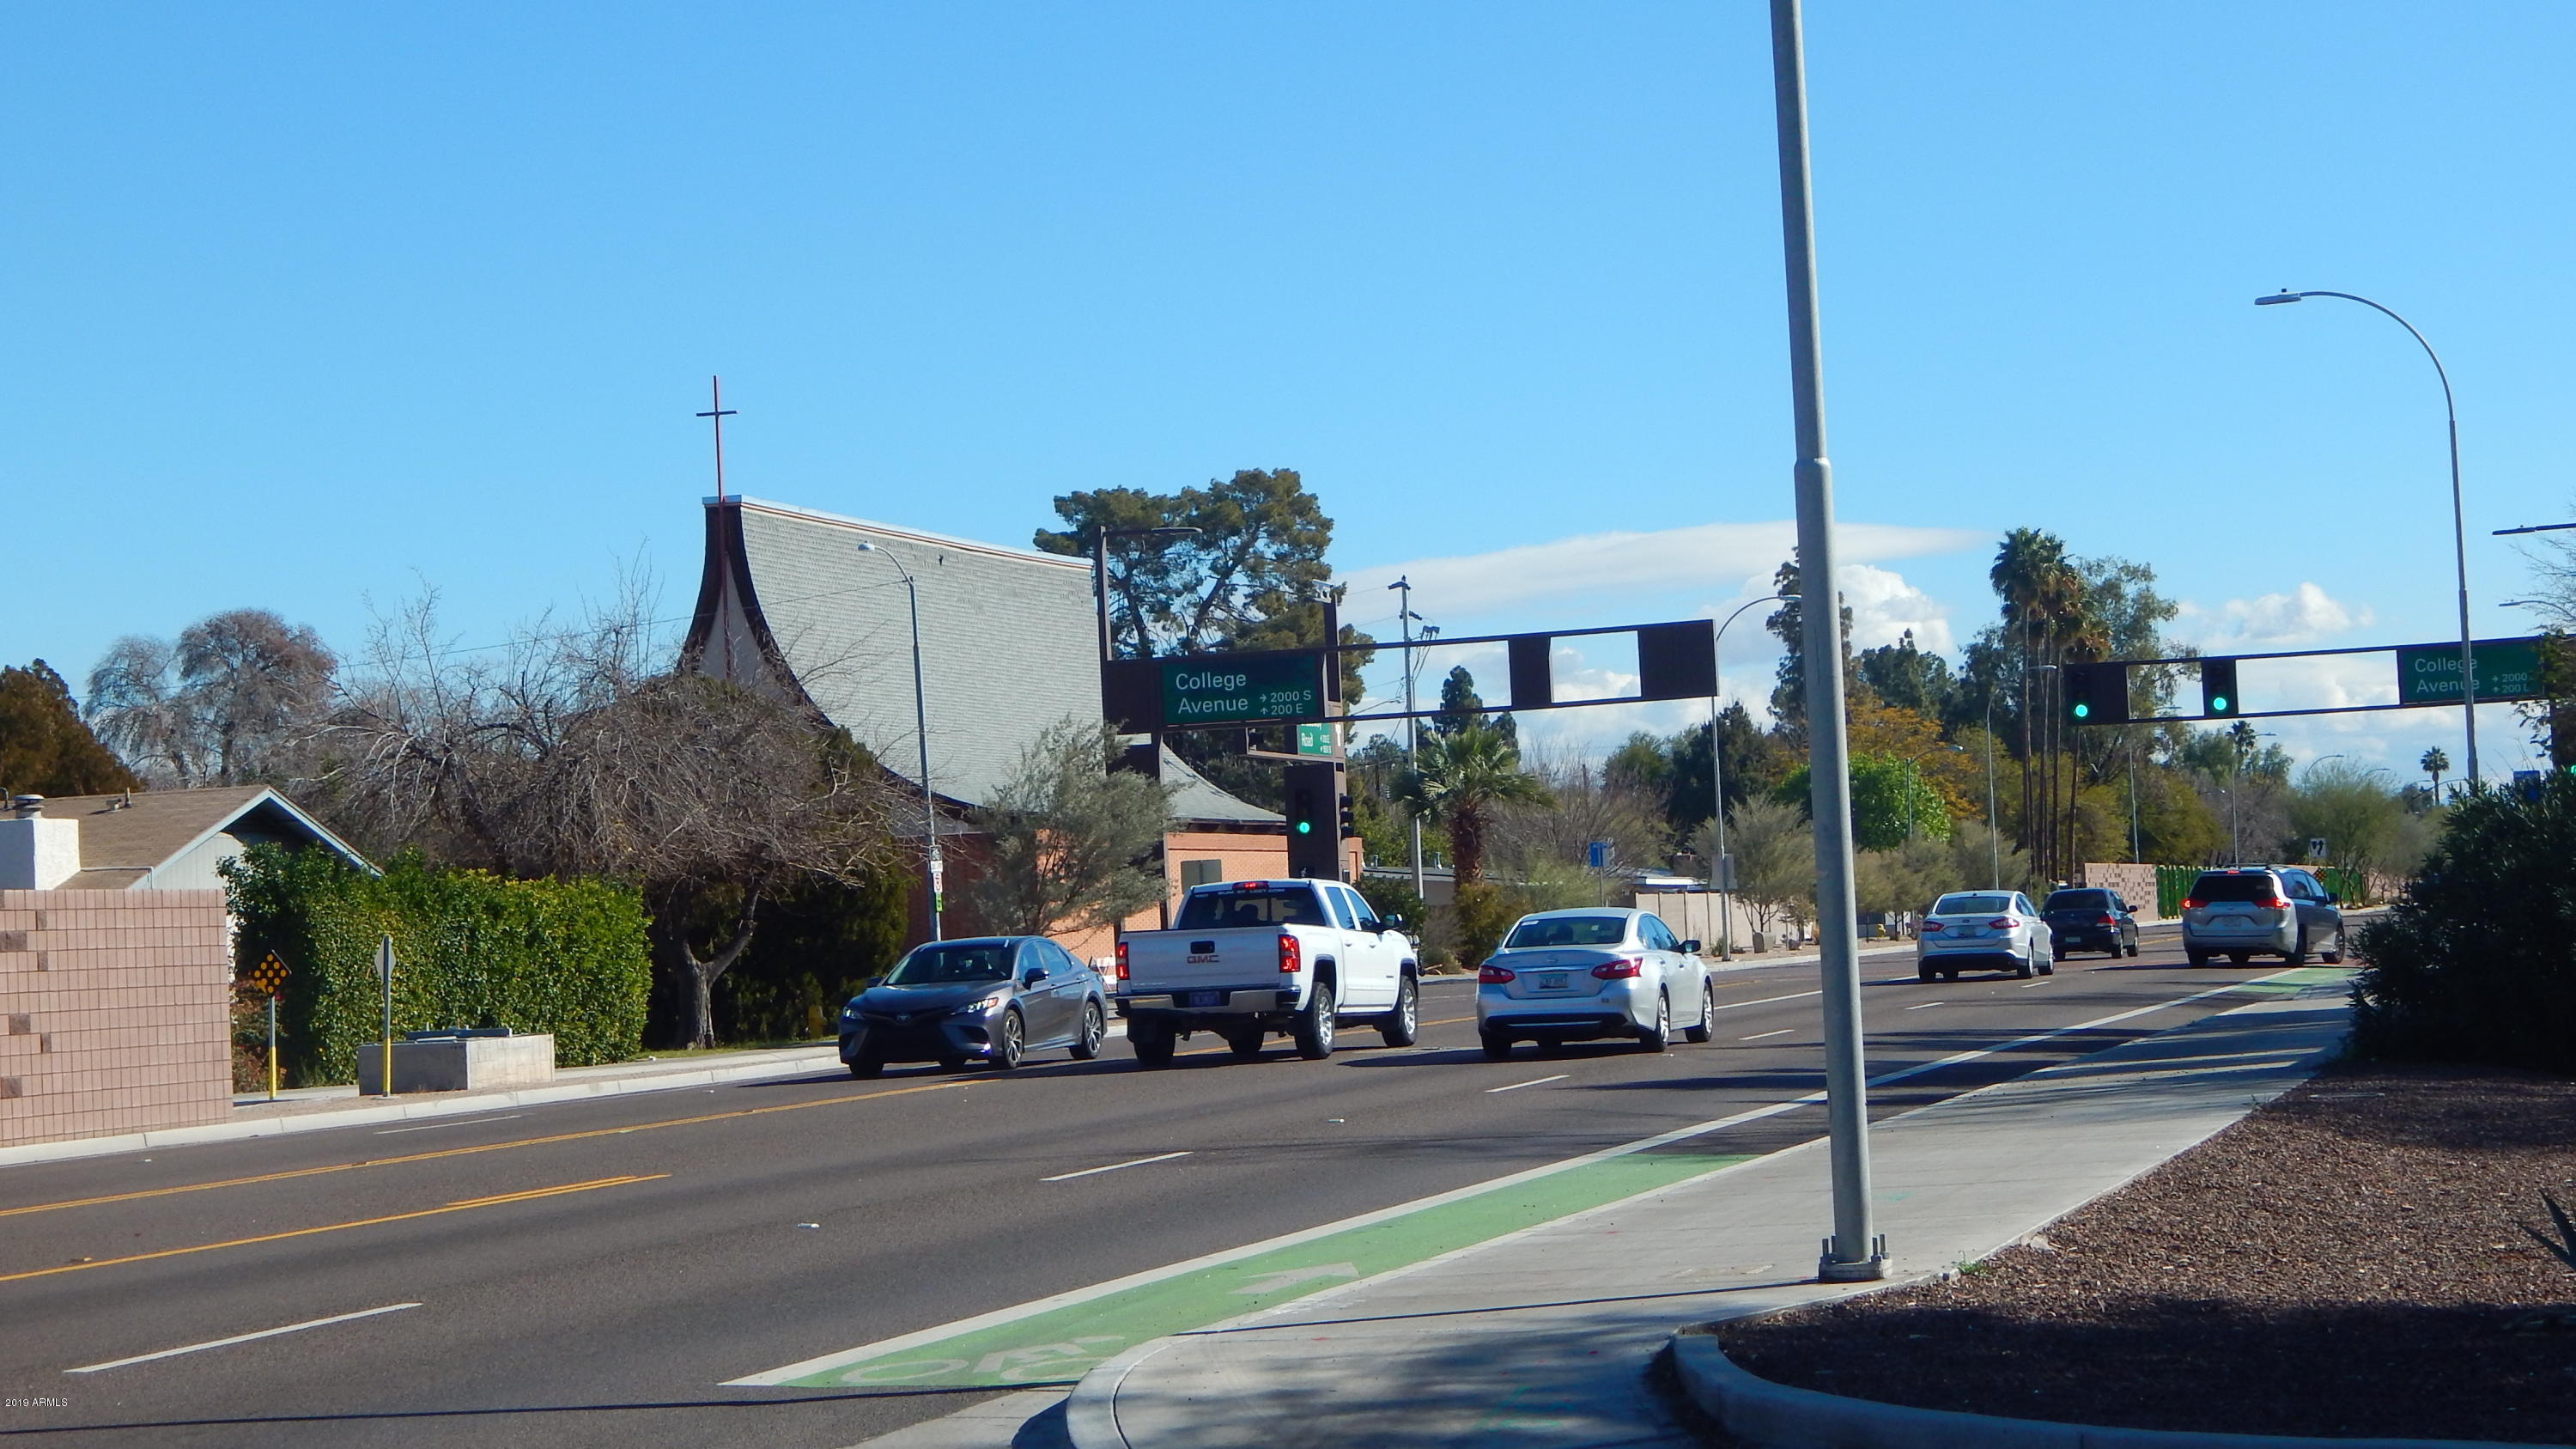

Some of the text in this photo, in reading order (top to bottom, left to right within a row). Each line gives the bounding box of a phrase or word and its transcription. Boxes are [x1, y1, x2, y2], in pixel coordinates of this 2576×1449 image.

[1176, 672, 1247, 691] College
[2502, 673, 2528, 683] 2000
[2502, 684, 2523, 694] 200
[1270, 690, 1312, 703] 2000 S
[1178, 697, 1249, 715] Avenue
[1271, 703, 1303, 715] 200 E
[1187, 954, 1219, 964] GMC
